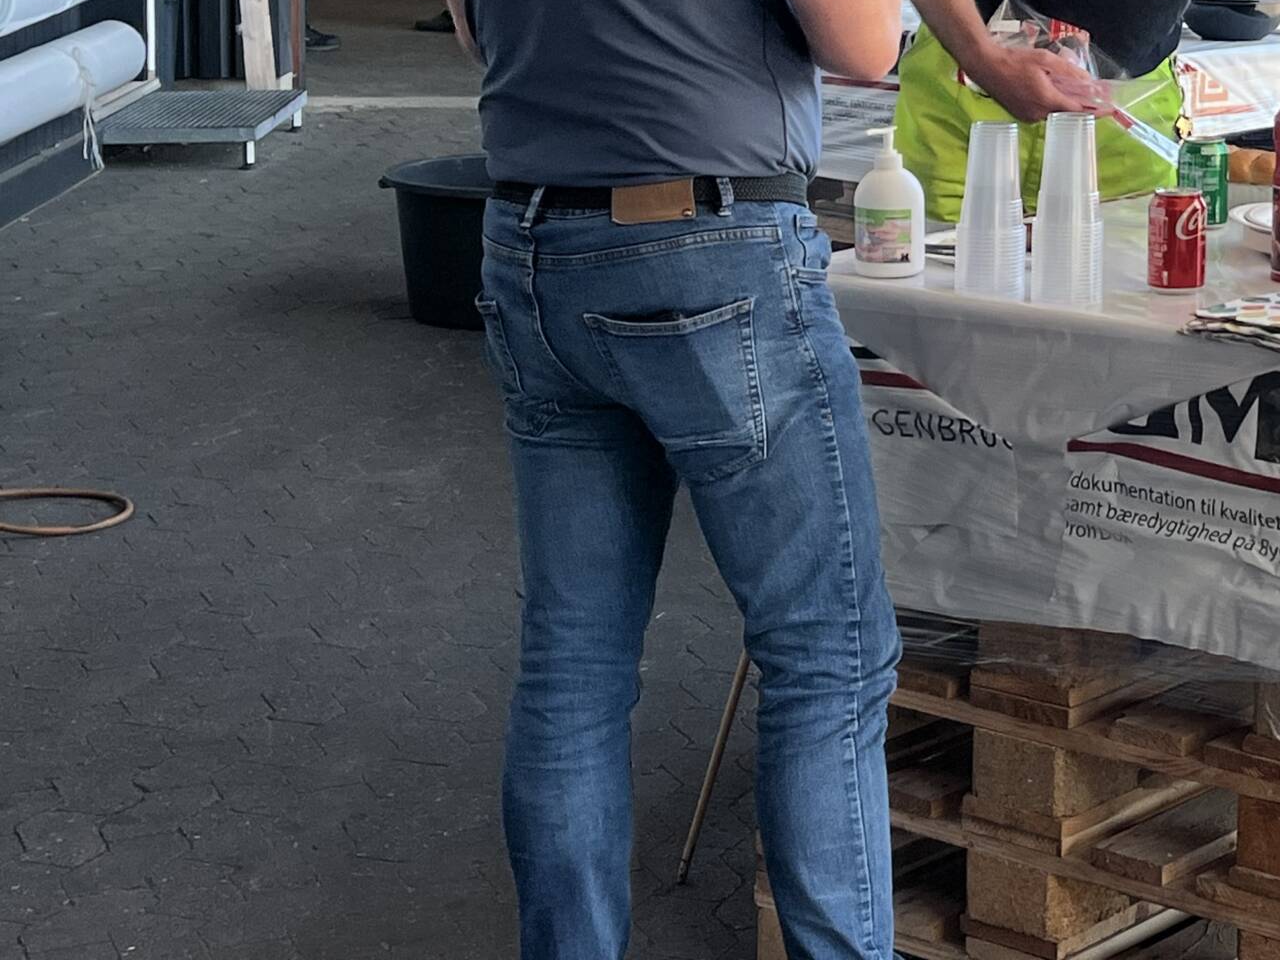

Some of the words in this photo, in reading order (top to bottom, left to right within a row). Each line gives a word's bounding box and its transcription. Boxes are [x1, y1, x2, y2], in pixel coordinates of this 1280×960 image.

[1069, 471, 1196, 513] dokumentation
[1200, 498, 1216, 517] til
[1106, 502, 1233, 545] bæredygtighed
[1232, 533, 1256, 551] på
